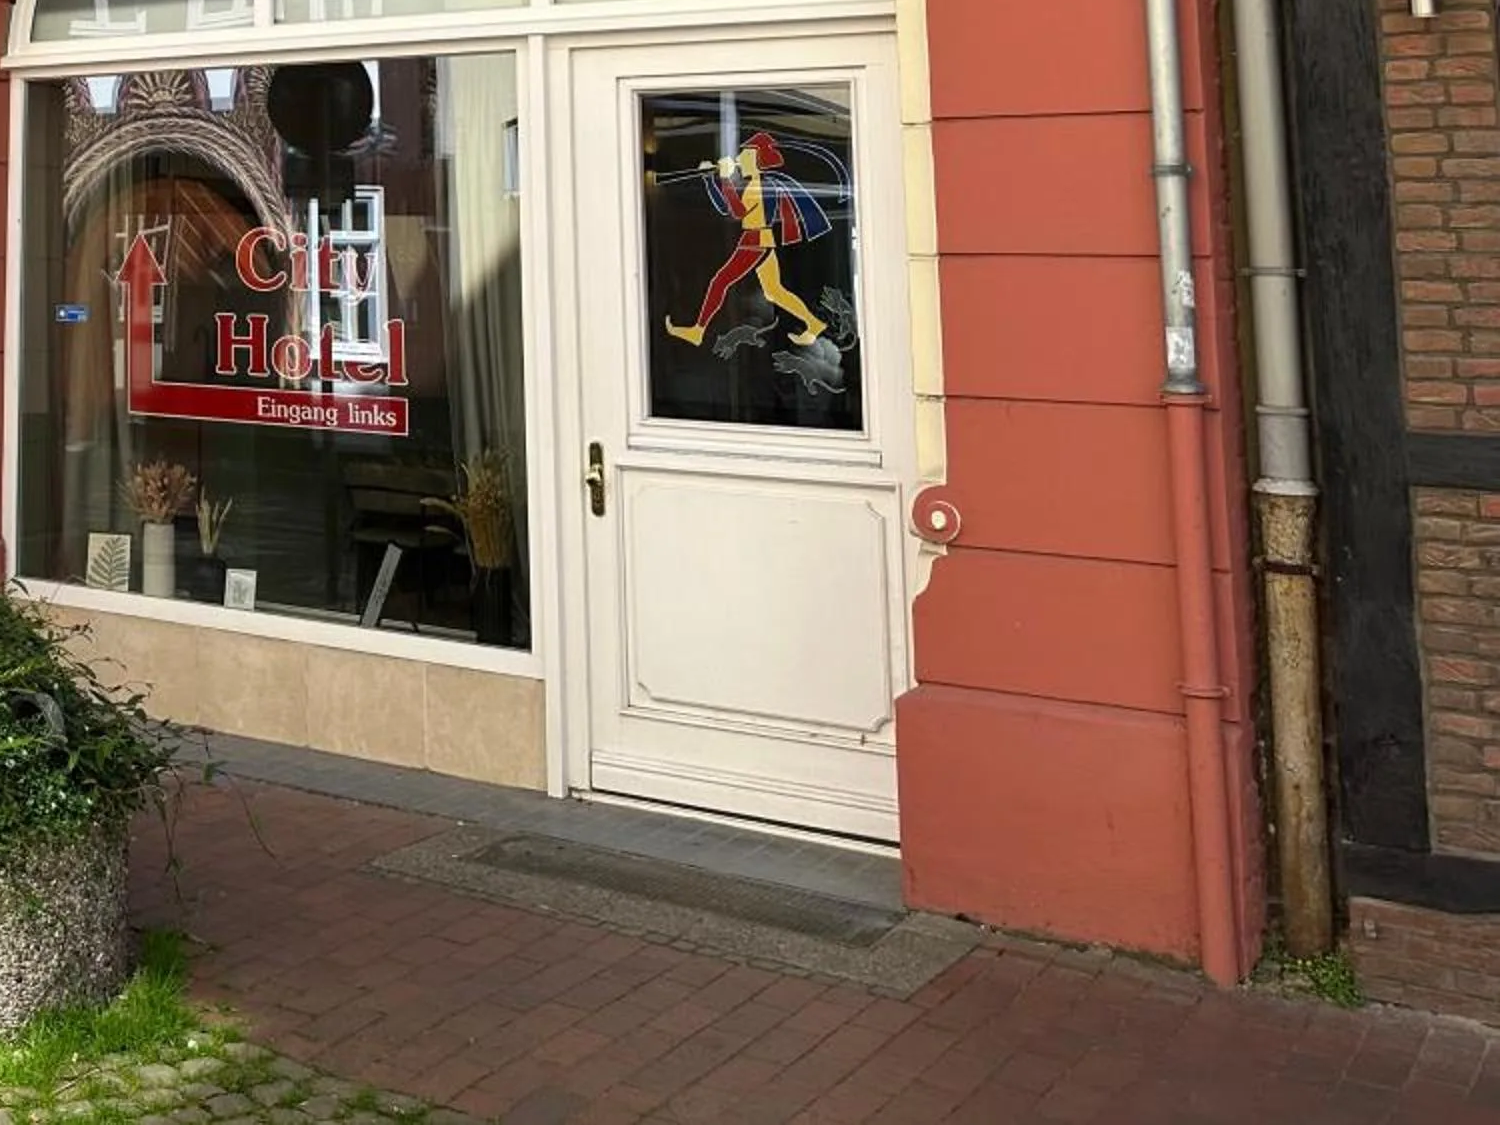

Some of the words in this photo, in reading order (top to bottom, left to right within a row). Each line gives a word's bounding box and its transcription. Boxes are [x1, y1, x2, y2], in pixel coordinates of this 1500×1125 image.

[235, 227, 379, 306] City
[214, 312, 409, 386] Hotel
[257, 396, 338, 425] Eingang
[347, 402, 397, 426] links
